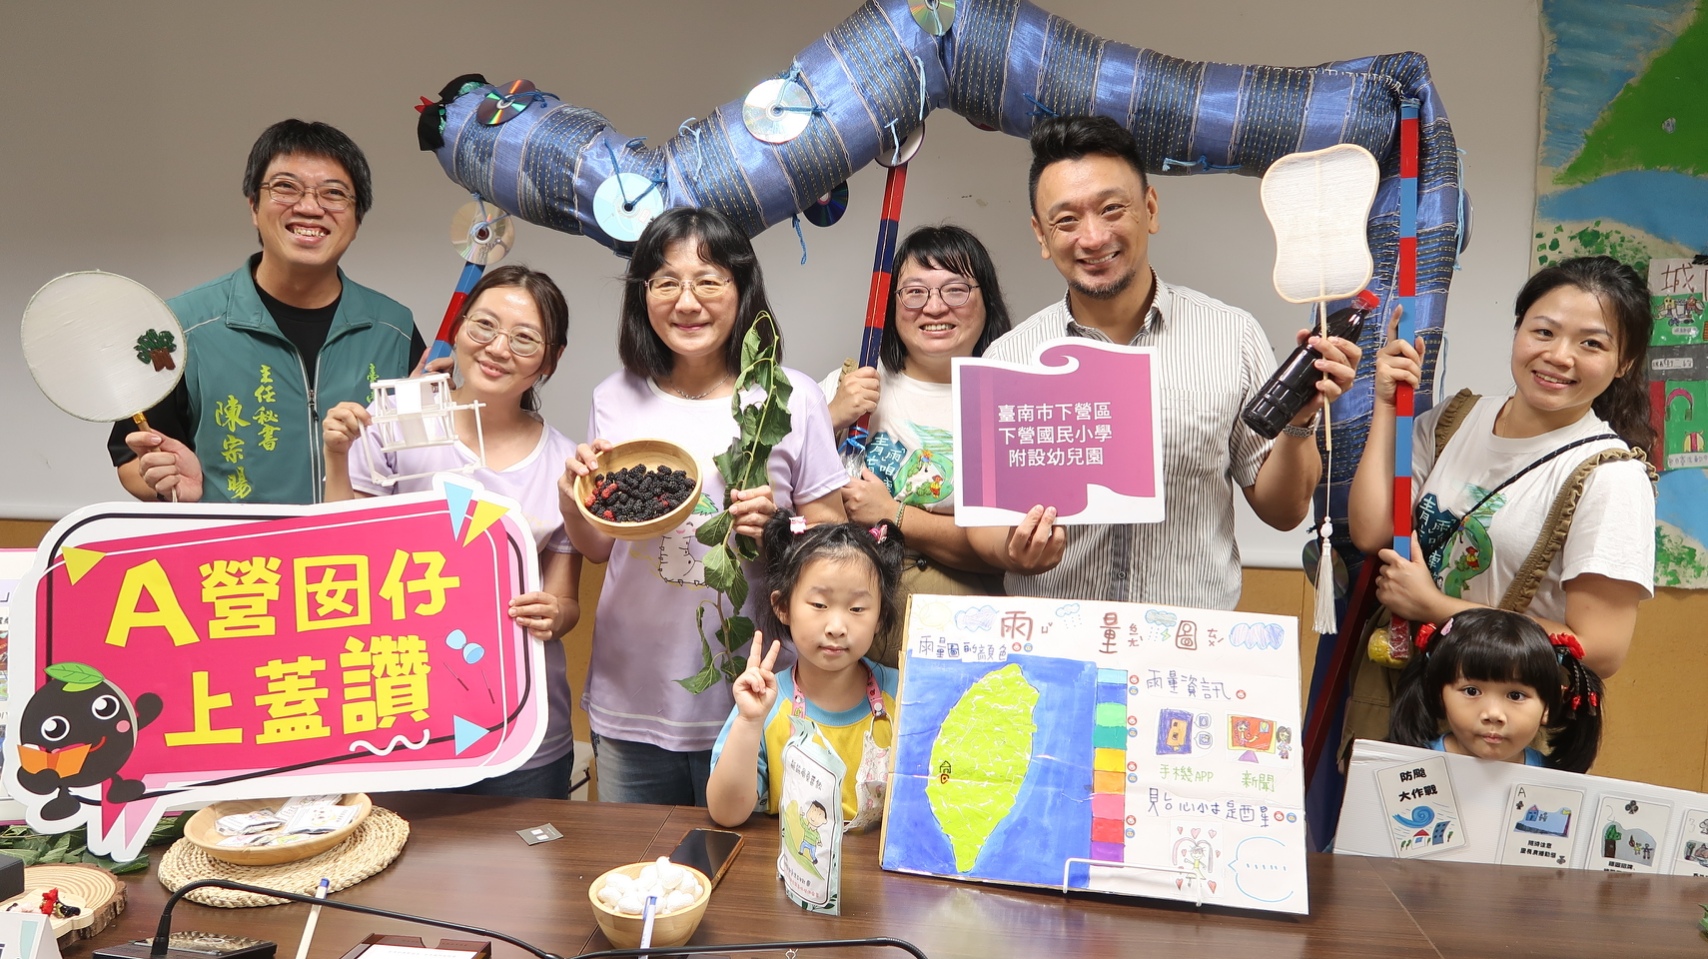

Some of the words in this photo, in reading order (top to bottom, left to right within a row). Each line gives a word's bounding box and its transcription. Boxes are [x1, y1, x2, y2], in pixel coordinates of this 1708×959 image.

[253, 364, 282, 451] 主任秘書
[998, 401, 1112, 422] 臺南市下營區
[998, 424, 1113, 445] 下營國民小學
[1008, 447, 1104, 467] 附設幼兒園
[105, 549, 460, 647] A營囡仔
[164, 635, 431, 747] 上蓋讚
[1146, 669, 1231, 700] 雨量資訊
[1241, 770, 1275, 792] 新聞
[1398, 784, 1438, 802] 大作戰
[1517, 787, 1526, 798] A
